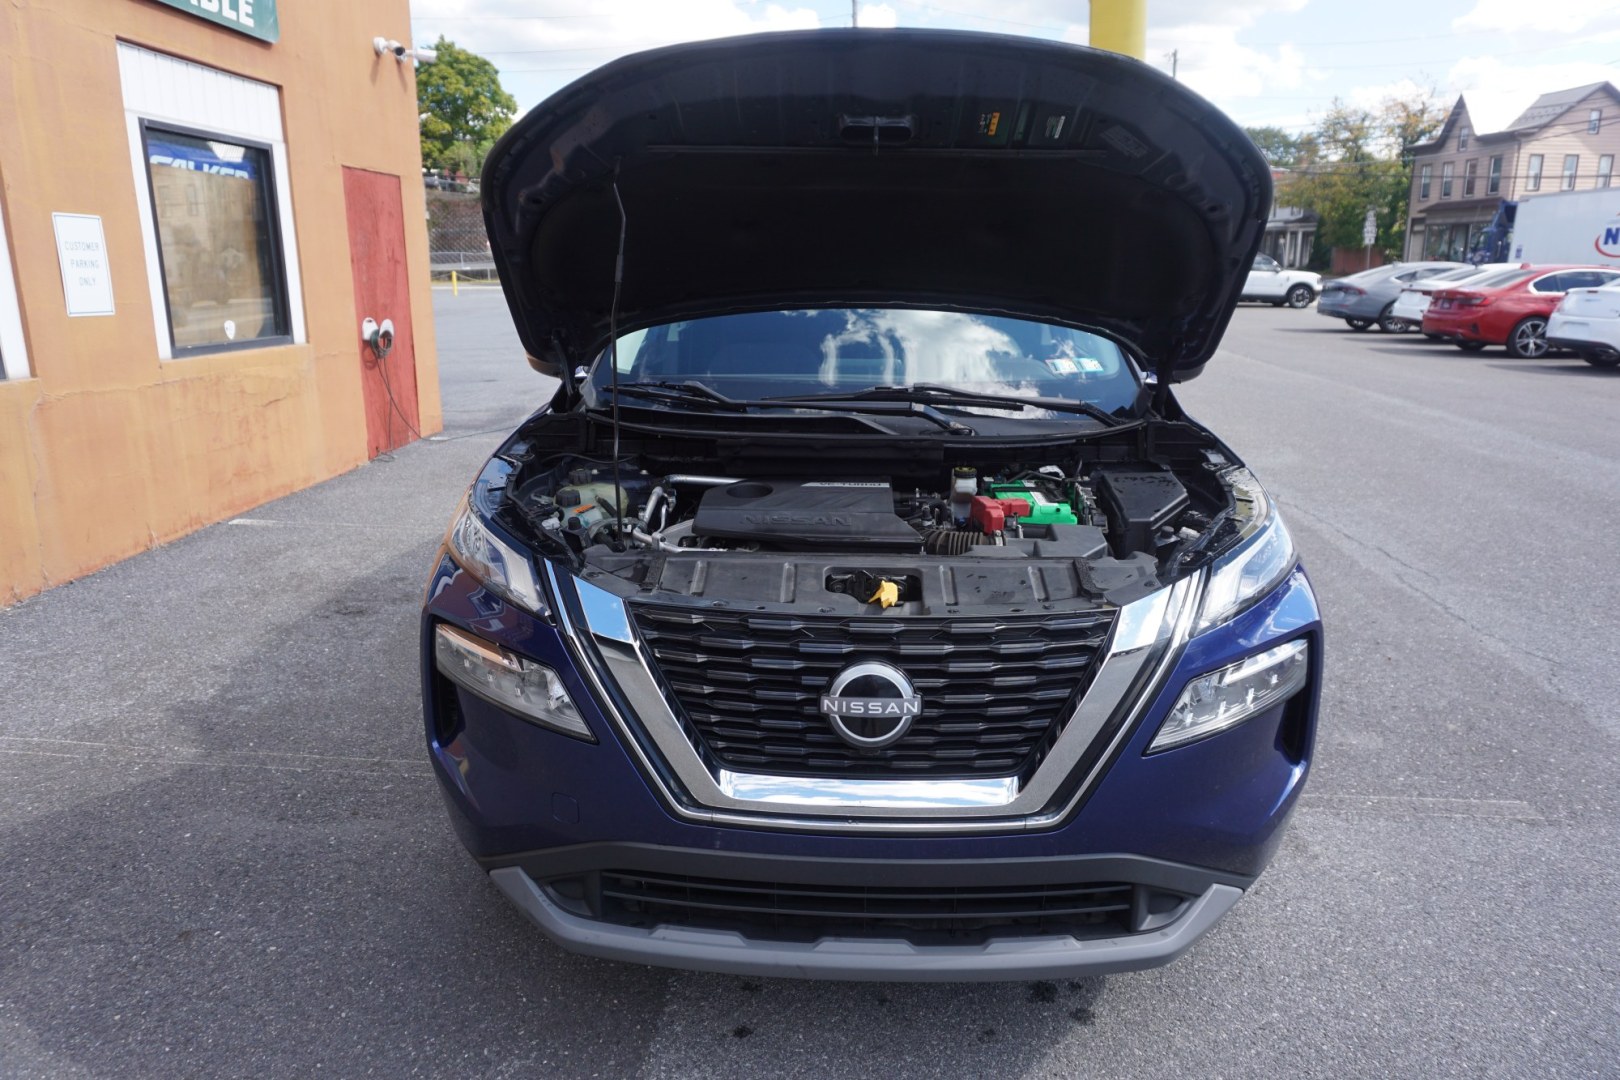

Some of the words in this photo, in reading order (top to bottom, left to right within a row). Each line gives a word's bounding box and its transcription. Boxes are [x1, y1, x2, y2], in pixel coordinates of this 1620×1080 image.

[189, 0, 254, 28] LE
[65, 241, 99, 251] CUSTOMER
[70, 259, 99, 269] PARKING
[79, 277, 96, 286] ONLY
[739, 514, 851, 526] NISSAN
[823, 699, 918, 714] NISSAN
